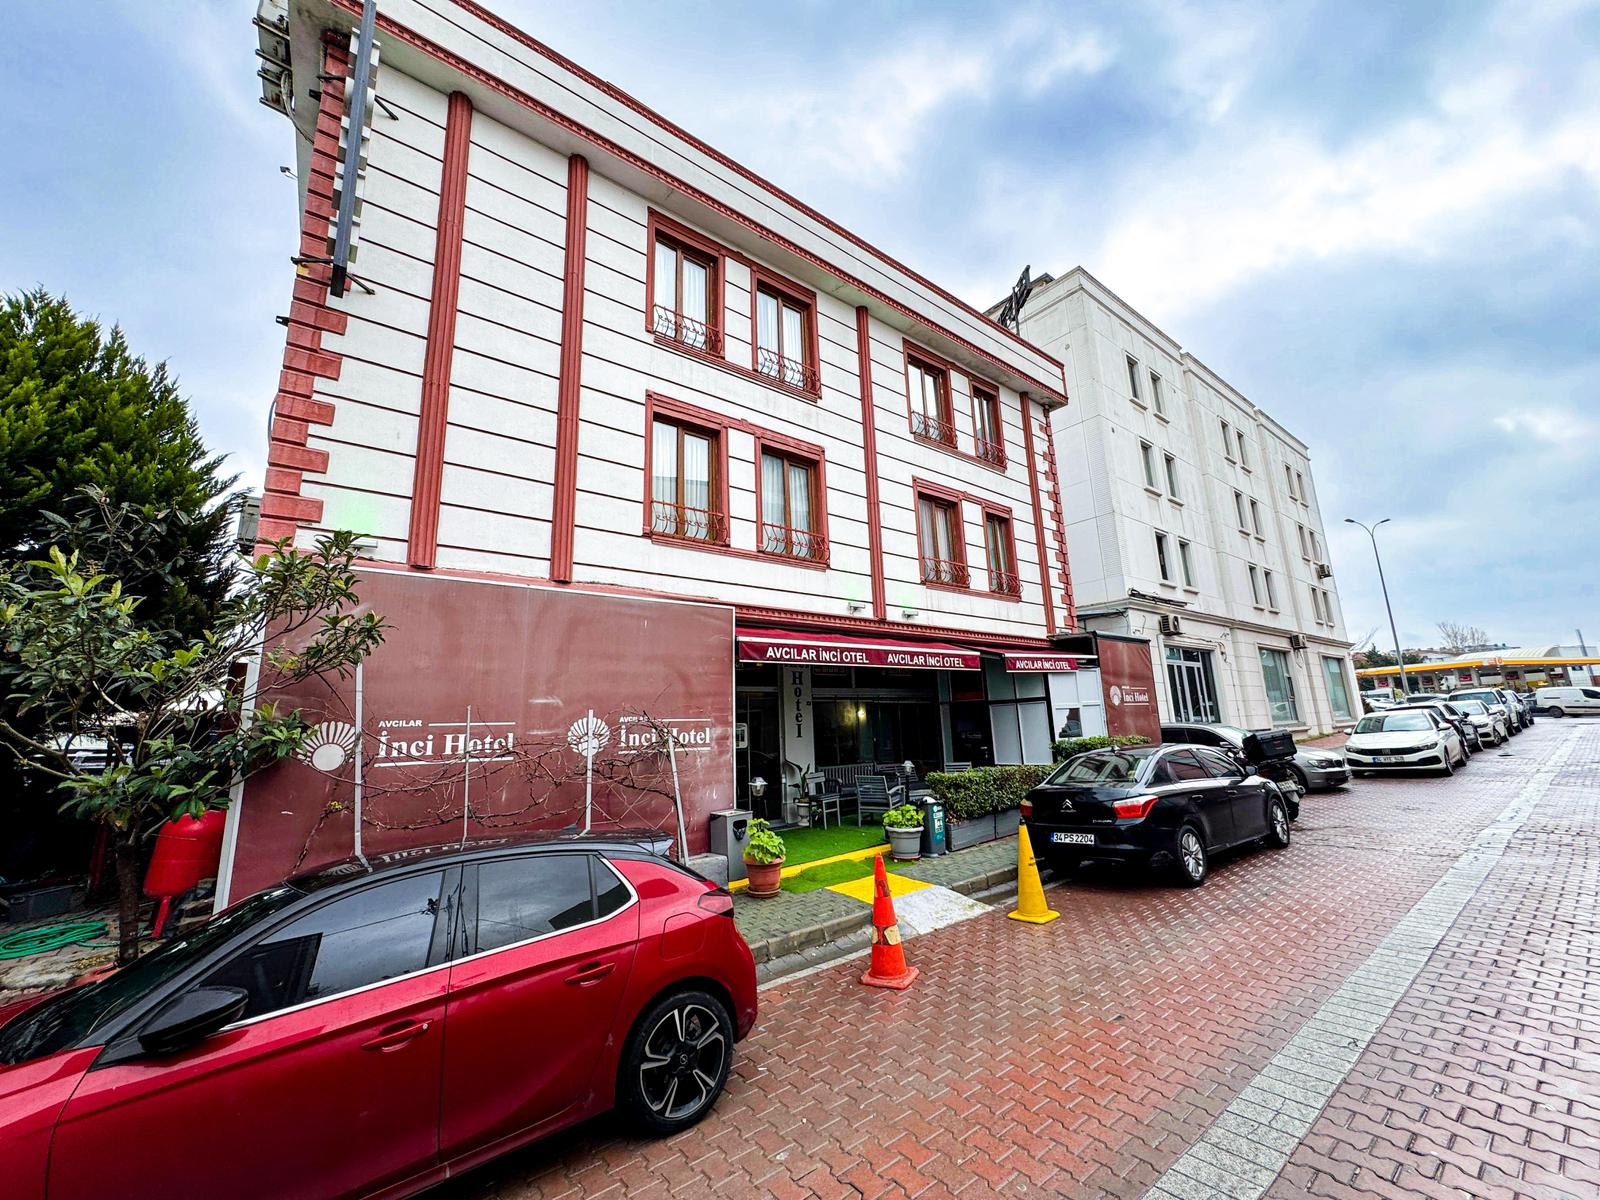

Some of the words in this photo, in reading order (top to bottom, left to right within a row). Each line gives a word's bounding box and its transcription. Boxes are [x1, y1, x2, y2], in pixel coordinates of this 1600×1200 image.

[766, 647, 817, 660] AVCILAR
[819, 648, 841, 662] İNCİ
[842, 652, 869, 663] OTEL
[887, 653, 925, 665] AVCILAR
[926, 654, 943, 667] İNCİ
[944, 657, 965, 667] OTEL
[1016, 659, 1043, 669] AVCILAR
[1055, 661, 1071, 670] OTEL
[792, 671, 803, 738] Hotel
[378, 719, 423, 728] AVCILAR
[443, 732, 514, 755] Hotel
[1054, 833, 1063, 842] 34
[1064, 834, 1075, 842] PS
[1075, 834, 1094, 844] 2204
